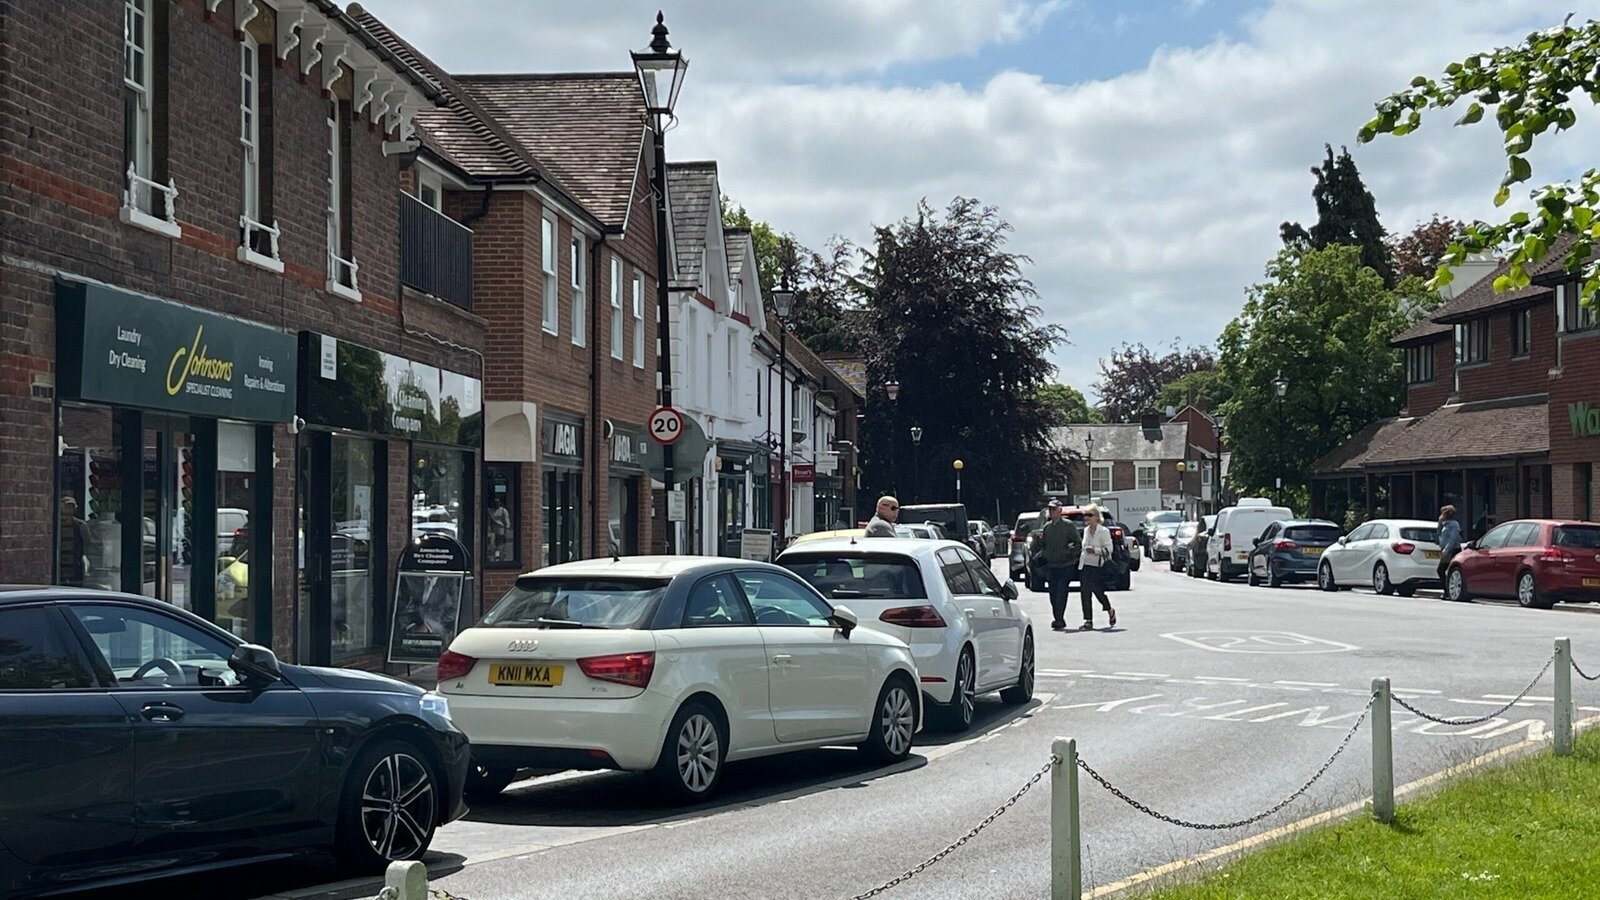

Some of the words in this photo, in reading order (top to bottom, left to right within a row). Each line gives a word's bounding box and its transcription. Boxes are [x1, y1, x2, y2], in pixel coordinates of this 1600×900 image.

[117, 325, 141, 347] Laundry
[109, 349, 120, 369] Dry
[121, 352, 146, 373] Cleaning
[167, 324, 233, 396] Johnsons
[185, 381, 210, 396] SPECIALIST
[210, 385, 233, 399] CLEANING
[654, 417, 679, 433] 20
[554, 423, 577, 456] AGA
[525, 666, 550, 682] MXA
